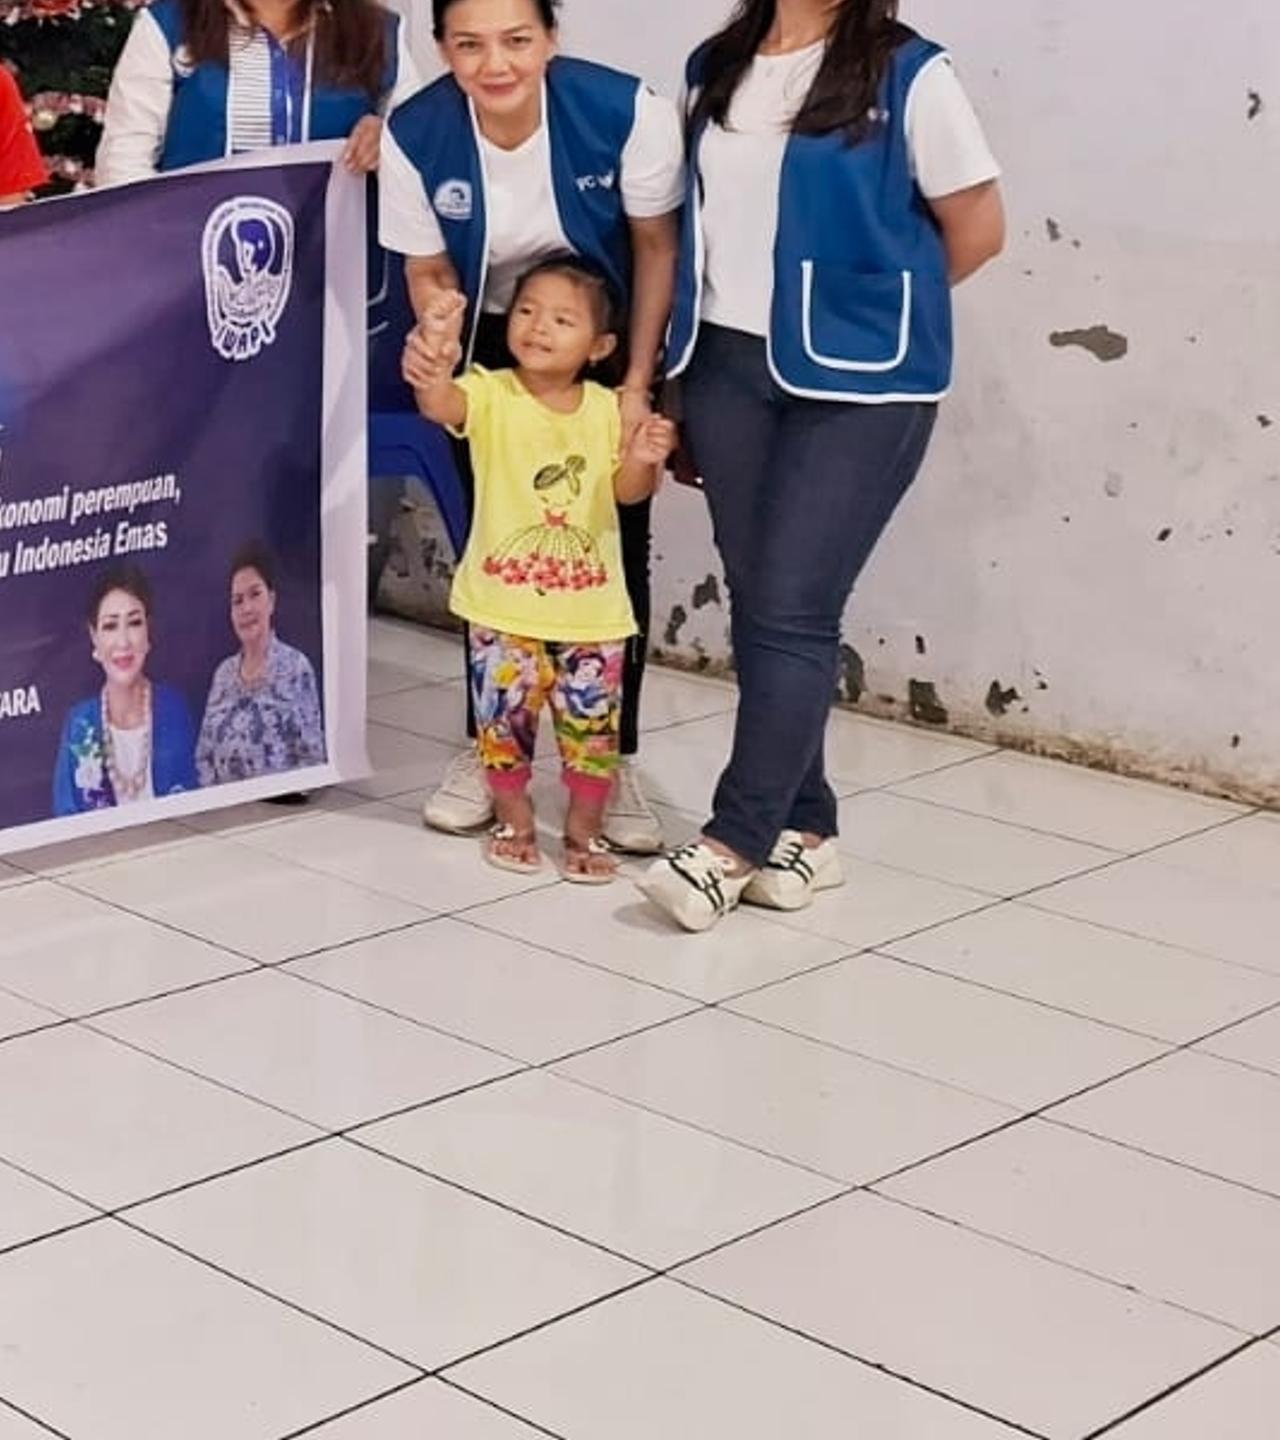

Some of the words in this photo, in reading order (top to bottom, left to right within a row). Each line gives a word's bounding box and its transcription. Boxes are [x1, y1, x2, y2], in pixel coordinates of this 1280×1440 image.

[215, 320, 272, 354] IWAPI
[70, 473, 181, 525] perempuan,
[13, 528, 112, 575] Indonesia
[113, 519, 168, 555] Emas
